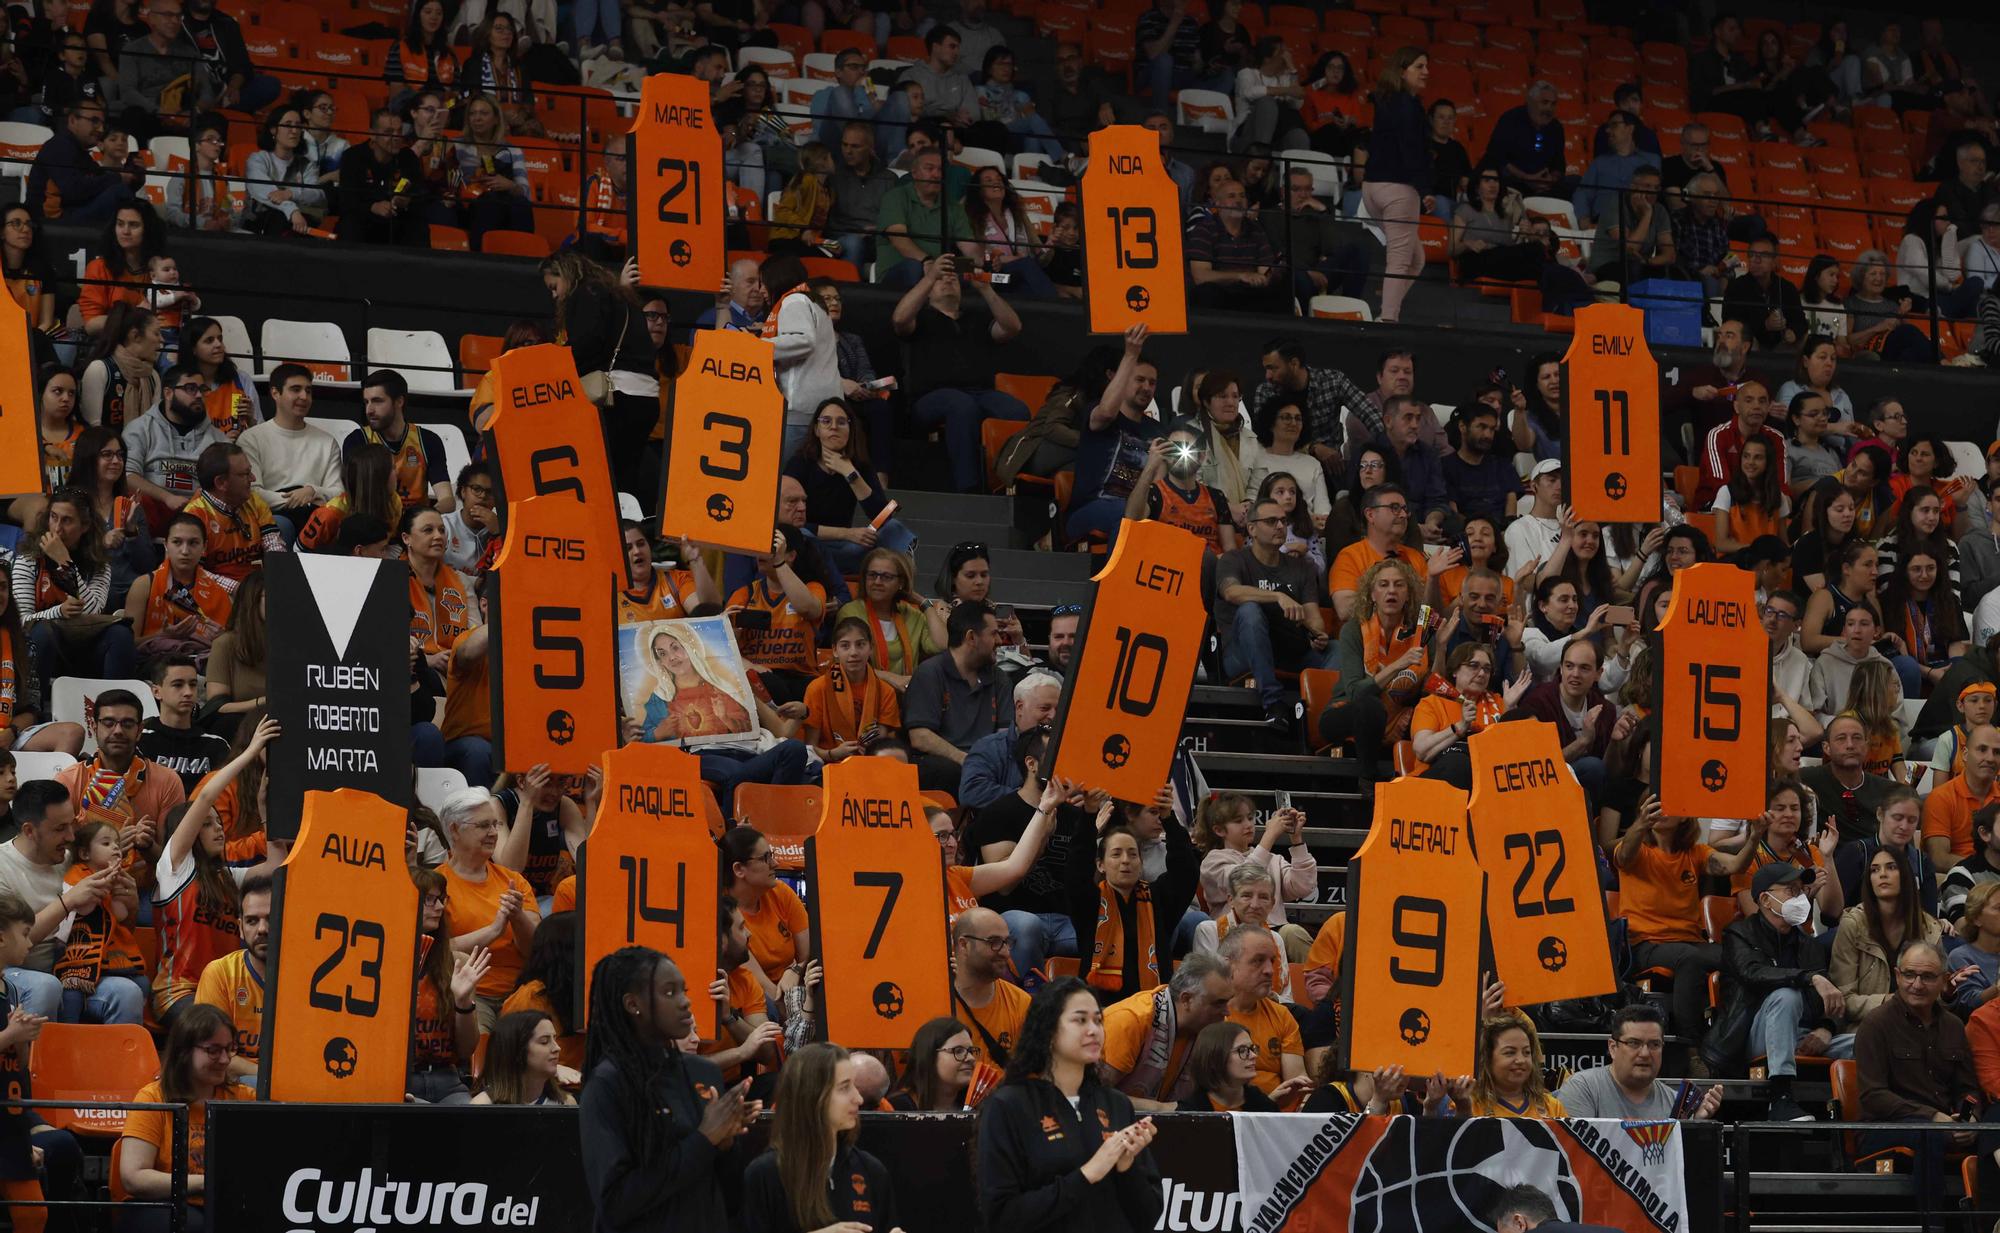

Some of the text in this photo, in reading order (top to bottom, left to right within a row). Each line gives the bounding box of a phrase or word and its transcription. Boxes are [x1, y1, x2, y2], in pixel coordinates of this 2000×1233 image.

[655, 102, 703, 129] MARIE
[1109, 155, 1143, 175] NOA
[657, 158, 701, 225] 21
[1107, 207, 1158, 269] 13
[1592, 334, 1634, 356] EMILY
[701, 358, 762, 385] ALBA
[512, 379, 575, 409] ELENA
[1594, 389, 1630, 456] 11
[699, 412, 752, 482] 3
[525, 536, 585, 562] CRIS
[1136, 560, 1184, 596] LETI
[1687, 598, 1746, 628] LAUREN
[532, 605, 585, 691] 5
[307, 661, 380, 691] RUBÉN
[1105, 626, 1168, 718] 10
[308, 704, 380, 733] ROBERTO
[1689, 663, 1742, 743] 15
[157, 755, 211, 774] PUMA
[307, 747, 379, 773] MARTA
[1493, 759, 1558, 793] CIERRA
[619, 784, 694, 819] RAQUEL
[842, 793, 912, 829] ÁNGELA
[321, 833, 386, 871] AWA
[1391, 818, 1459, 856] QUERALT
[1504, 829, 1575, 918] 22
[619, 855, 686, 951] 14
[854, 871, 904, 960] 7
[1390, 896, 1447, 987] 9
[310, 913, 385, 1018] 23
[283, 1167, 540, 1226] Cultura del
